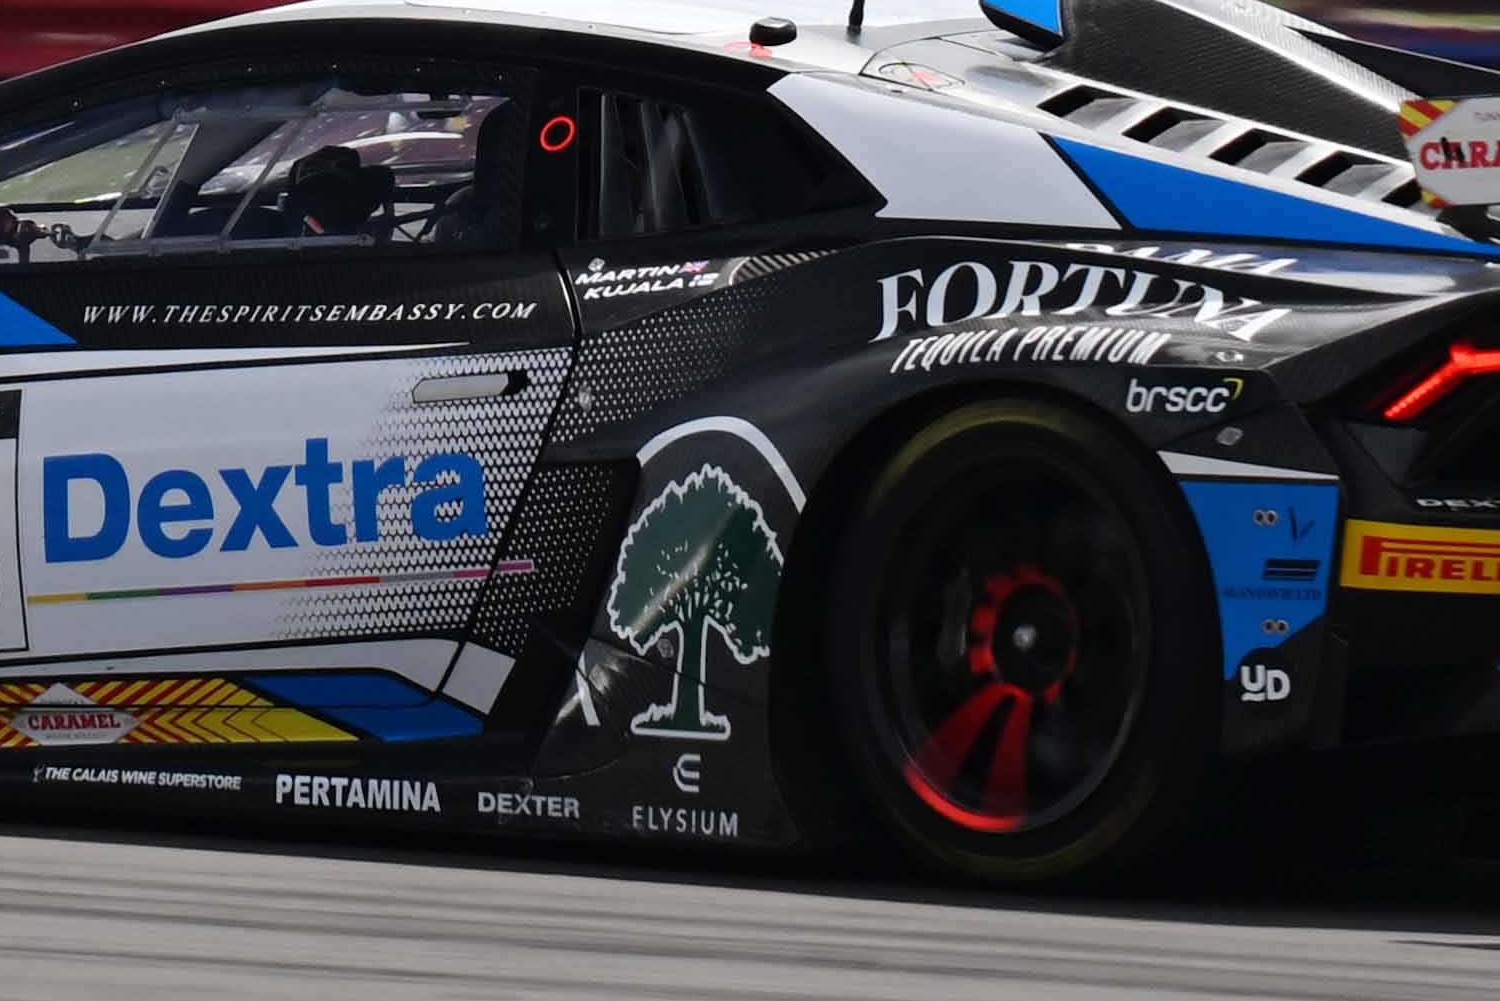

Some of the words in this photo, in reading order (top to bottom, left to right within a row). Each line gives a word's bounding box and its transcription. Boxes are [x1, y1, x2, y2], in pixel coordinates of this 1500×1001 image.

[575, 264, 681, 285] MARTIN
[583, 277, 684, 300] KUJALA
[82, 302, 537, 324] WWW.THESPIRITSEMBASSY.COM
[869, 260, 1292, 342] FORTUNA
[890, 327, 1020, 374] TEQUILA
[1013, 325, 1172, 365] PREMIUM
[1126, 379, 1229, 413] brscc
[43, 437, 489, 564] Dextra
[27, 711, 122, 730] CARAMEL
[45, 767, 71, 780] THE
[72, 768, 119, 783] CALAIS
[121, 770, 157, 785] WINE
[158, 772, 242, 790] SUPERSTORE
[275, 774, 441, 812] PERTAMINA
[478, 791, 580, 818] DEXTER
[632, 805, 738, 837] ELYSIUM
